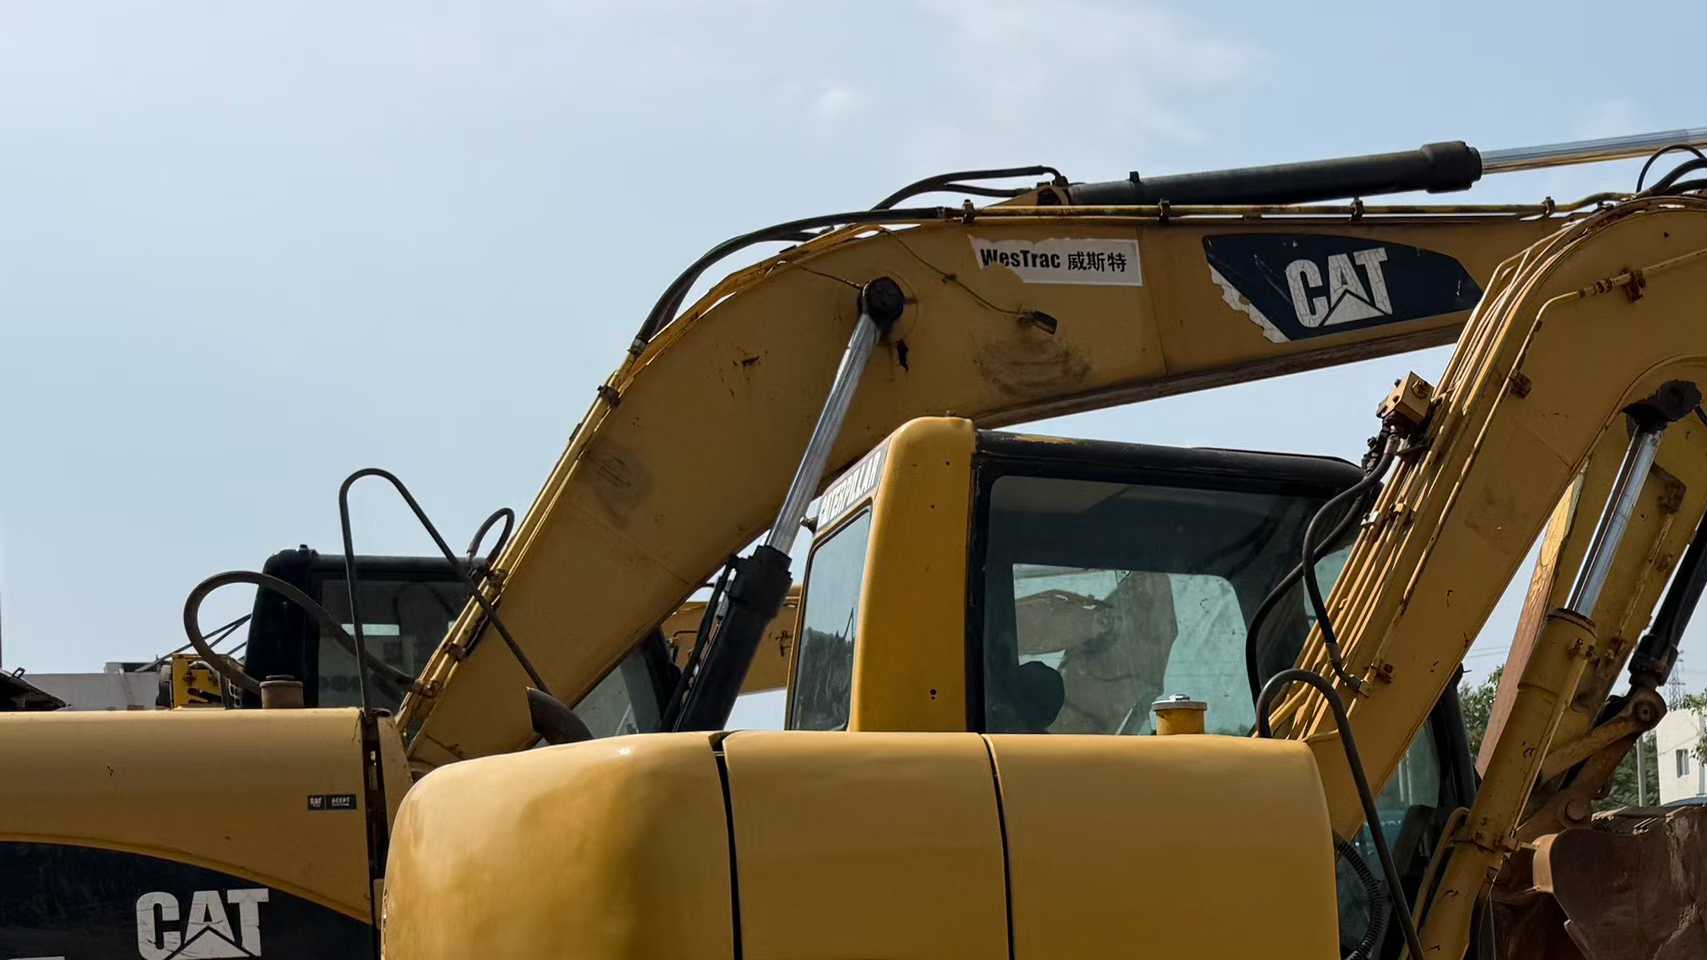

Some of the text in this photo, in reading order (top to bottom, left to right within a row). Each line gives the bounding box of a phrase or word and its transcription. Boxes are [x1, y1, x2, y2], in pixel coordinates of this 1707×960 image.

[980, 248, 1127, 272] WesTrac 威斯特
[1285, 247, 1394, 329] CAT
